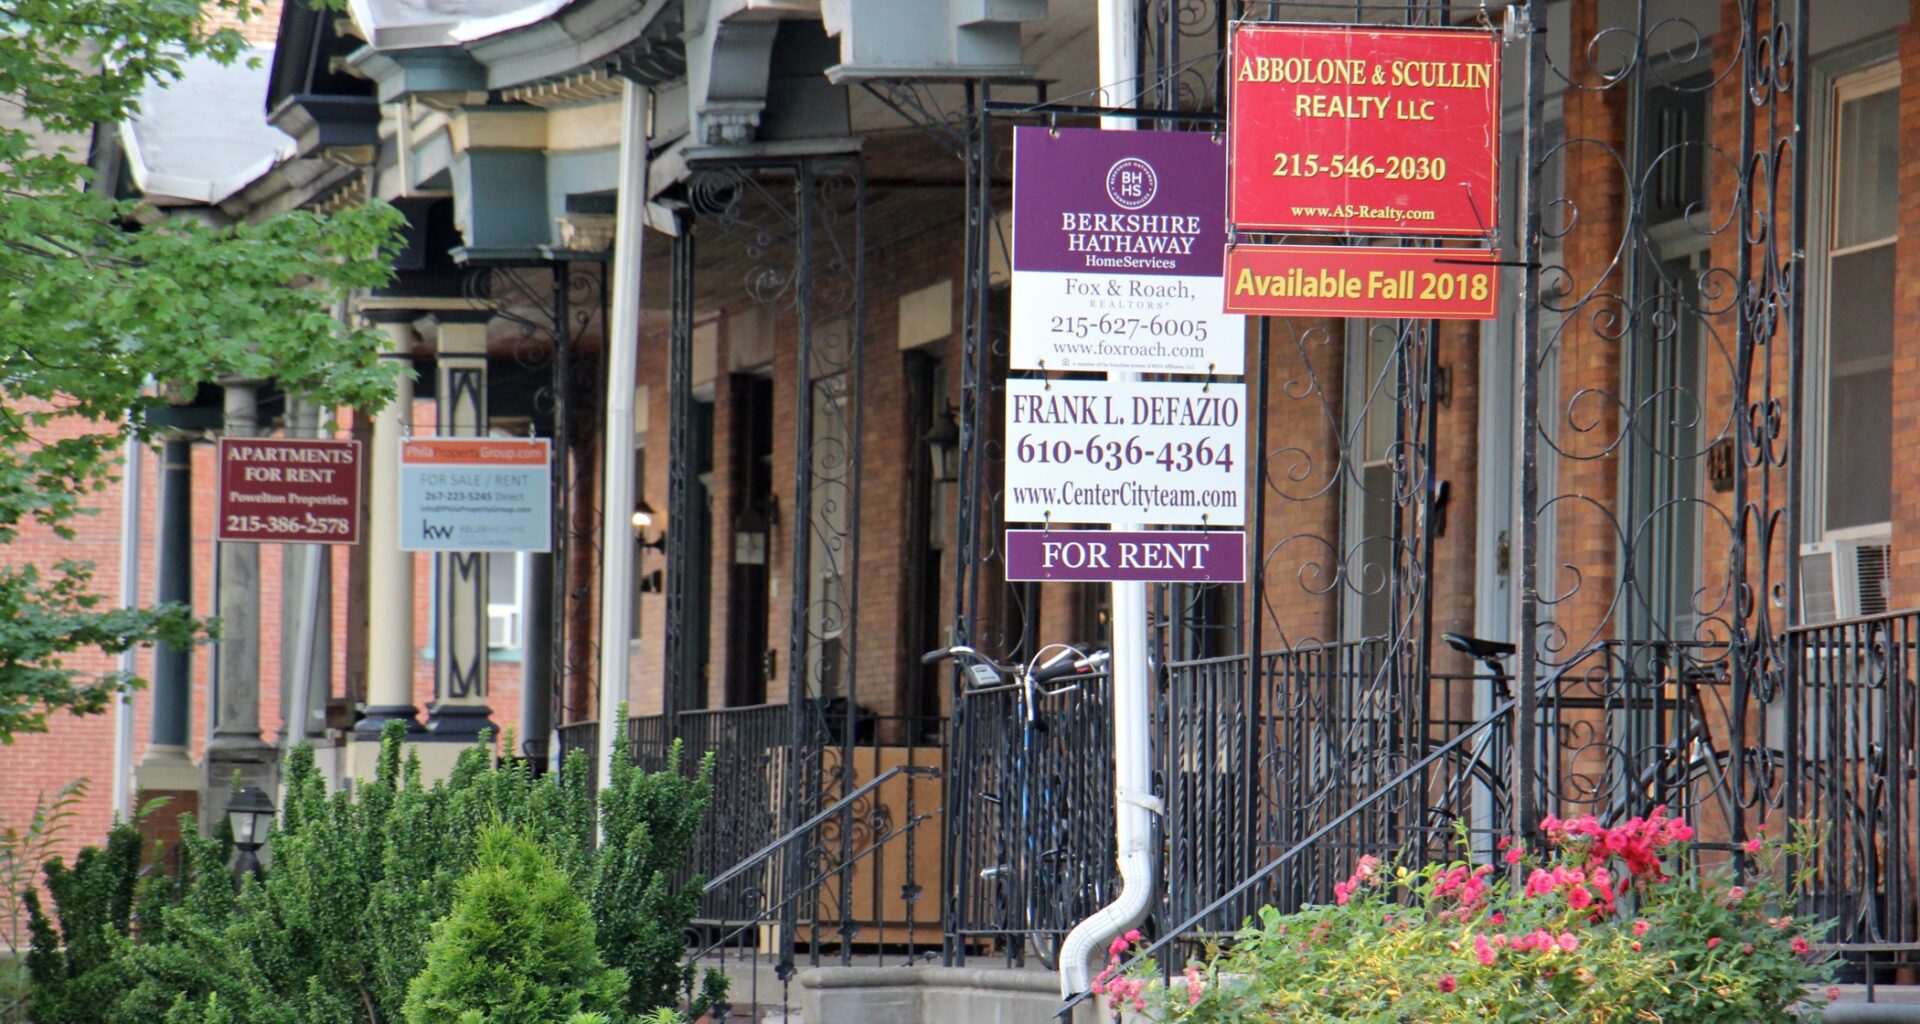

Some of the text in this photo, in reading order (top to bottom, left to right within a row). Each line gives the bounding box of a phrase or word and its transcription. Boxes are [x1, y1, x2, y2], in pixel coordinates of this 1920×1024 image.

[1238, 57, 1492, 88] ABBOLONE & SCULLIN
[1295, 95, 1435, 121] REALTY LLC
[1122, 171, 1142, 184] BH
[1272, 153, 1447, 181] 215-546-2030
[1122, 184, 1142, 197] HS
[1061, 212, 1201, 235] BERKSHIRE
[1291, 204, 1435, 222] www.AS-Realty.com
[1068, 234, 1195, 255] HATHAWAY
[1085, 254, 1177, 269] HomeServices
[1065, 278, 1196, 301] Fox & Roach,
[1234, 268, 1489, 301] Available Fall 2018
[1051, 312, 1208, 342] 215-627-6005
[1053, 340, 1205, 358] www.foxroach.com
[1013, 394, 1239, 427] FRANK L. DEFAZIO
[227, 446, 354, 464] APARTMENTS
[1017, 433, 1234, 473] 610-636-4364
[244, 466, 336, 483] FOR RENT
[419, 473, 447, 486] FOR
[450, 473, 481, 487] SALE
[495, 474, 529, 487] RENT
[229, 490, 349, 507] Powelton Properties
[495, 492, 524, 502] Direct
[1013, 480, 1238, 513] www.CenterCityteam.com
[227, 514, 350, 535] 215-386-2578
[422, 518, 455, 540] kw
[1041, 541, 1210, 569] FOR RENT
